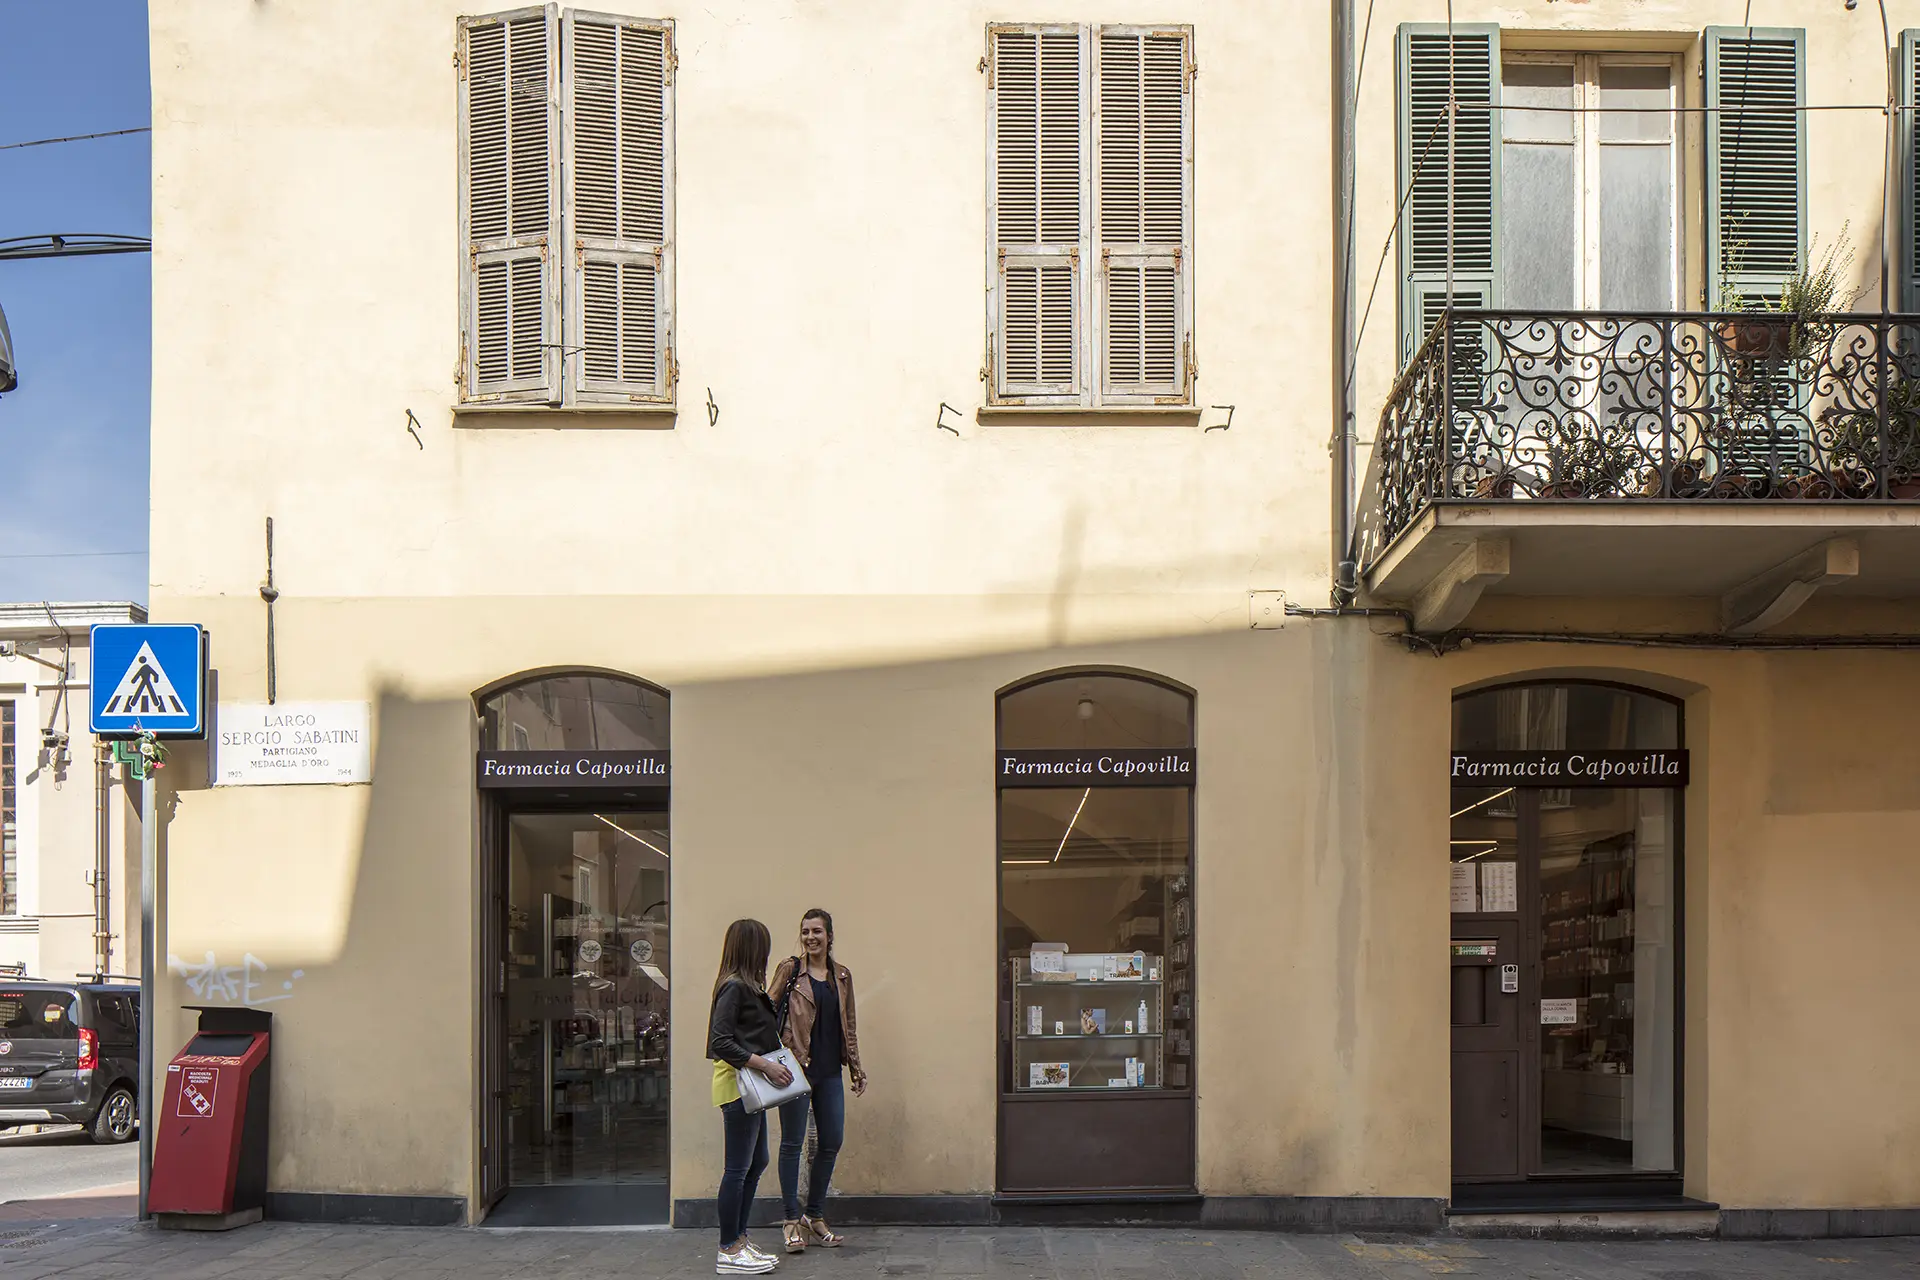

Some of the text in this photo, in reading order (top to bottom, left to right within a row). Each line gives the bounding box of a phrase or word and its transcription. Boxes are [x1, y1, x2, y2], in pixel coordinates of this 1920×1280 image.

[264, 714, 316, 728] LARGO
[222, 729, 359, 746] SERGIO SABATINI
[262, 746, 318, 756] PARTIGIANO
[250, 759, 329, 769] MEDAGLIA D'ORO
[483, 758, 666, 779] Farmacia Capovilla
[1003, 755, 1191, 777] Farmacia Capovilla
[1451, 754, 1679, 781] Farmacia Capovilla
